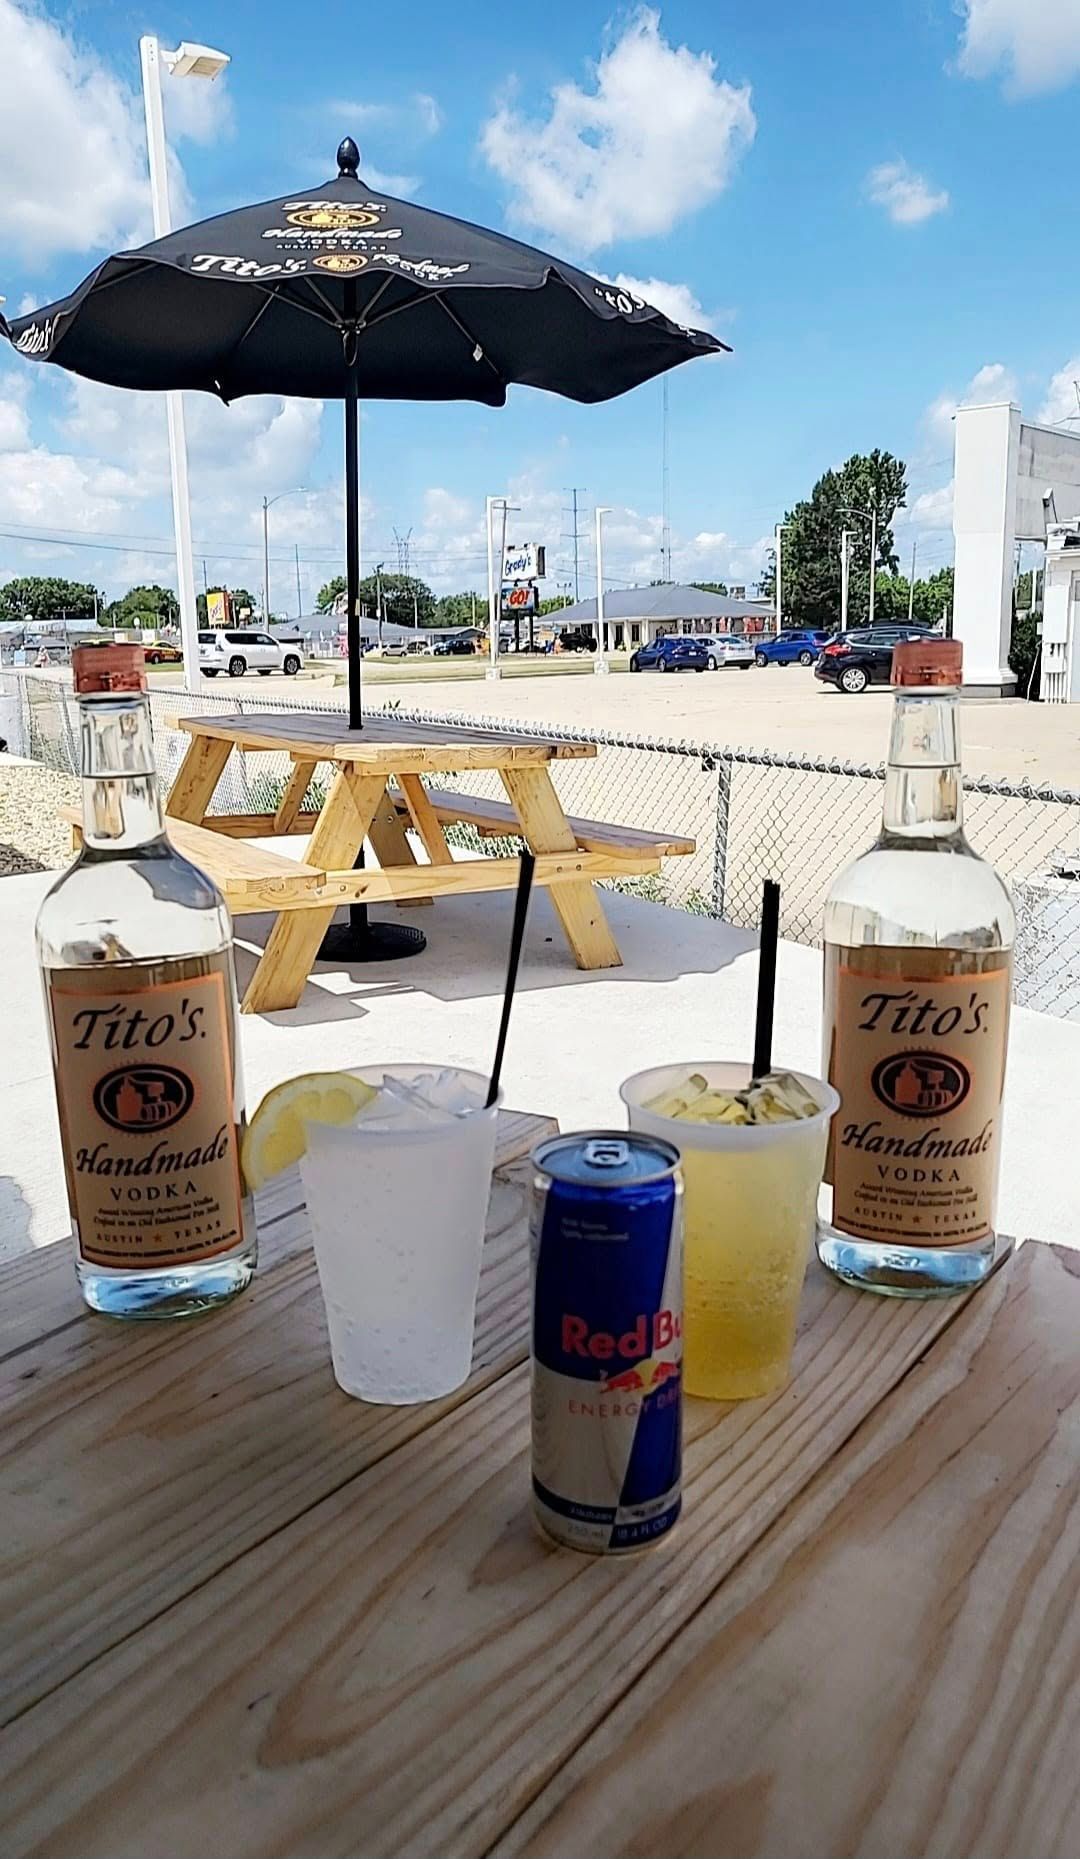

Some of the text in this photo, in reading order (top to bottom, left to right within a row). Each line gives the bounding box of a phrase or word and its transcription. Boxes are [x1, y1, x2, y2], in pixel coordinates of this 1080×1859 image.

[262, 227, 402, 239] Handmade
[509, 590, 530, 605] GO!
[76, 1123, 228, 1177] Handmade
[877, 1165, 961, 1183] VODKA
[110, 1180, 197, 1201] VODKA
[854, 1206, 976, 1224] AUSTIN TEXAS
[96, 1220, 221, 1243] AUSTIN TEXAS
[561, 1313, 648, 1359] Red
